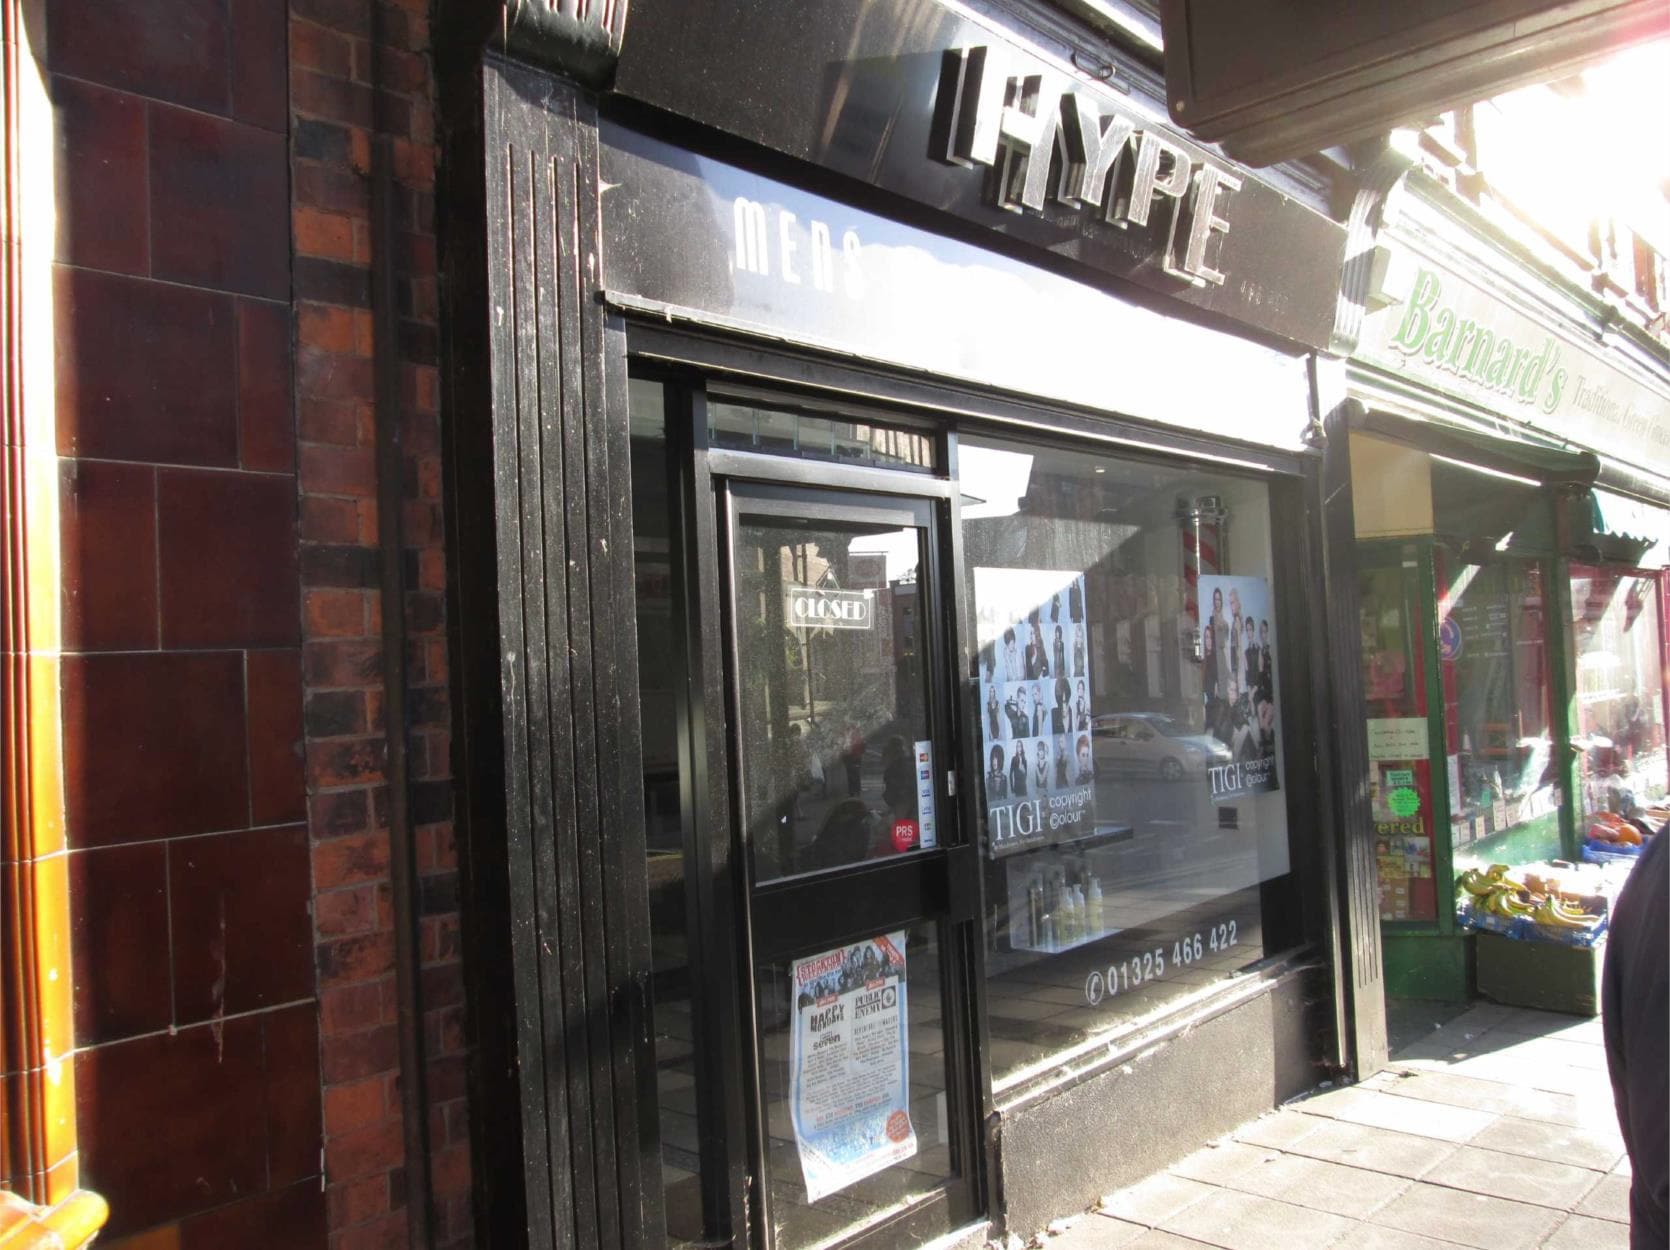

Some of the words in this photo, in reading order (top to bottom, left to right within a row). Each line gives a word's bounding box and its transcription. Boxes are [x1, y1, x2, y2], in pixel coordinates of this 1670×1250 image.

[947, 45, 1242, 288] HYPE
[1389, 266, 1568, 415] Barnard's
[794, 596, 867, 621] CLOSED
[1208, 763, 1242, 794] TIGI
[1049, 787, 1092, 809] copyright
[895, 824, 913, 838] PRS
[990, 799, 1043, 841] TIGI
[1375, 817, 1426, 836] ered
[1108, 948, 1164, 995] 01325
[1172, 933, 1202, 967] 466
[1210, 920, 1238, 952] 422
